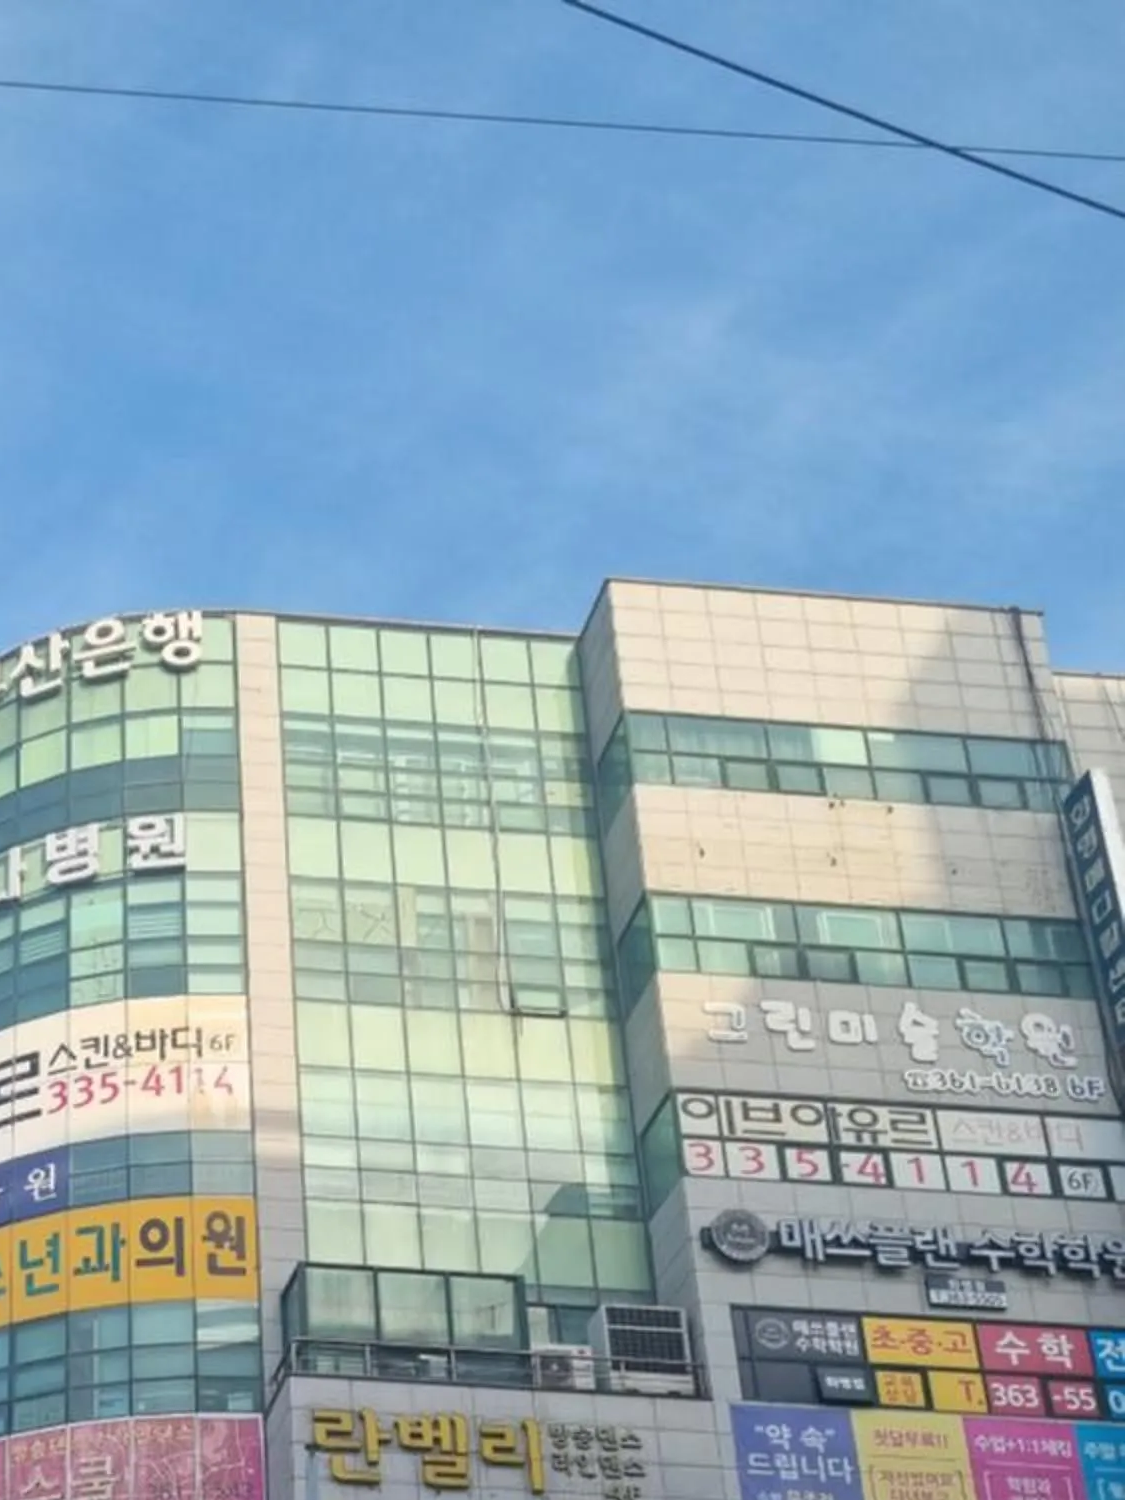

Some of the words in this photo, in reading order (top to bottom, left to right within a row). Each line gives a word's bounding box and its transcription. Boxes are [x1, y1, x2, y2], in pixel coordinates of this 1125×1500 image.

[47, 1028, 203, 1076] 스킨&바디
[210, 1034, 235, 1051] 6F
[681, 1097, 934, 1148] 이브아유르
[778, 1217, 961, 1270] 매쓰플랜
[994, 1330, 1074, 1369] 수학
[313, 1407, 546, 1496] 란벨리
[747, 1452, 855, 1486] 드립니다
